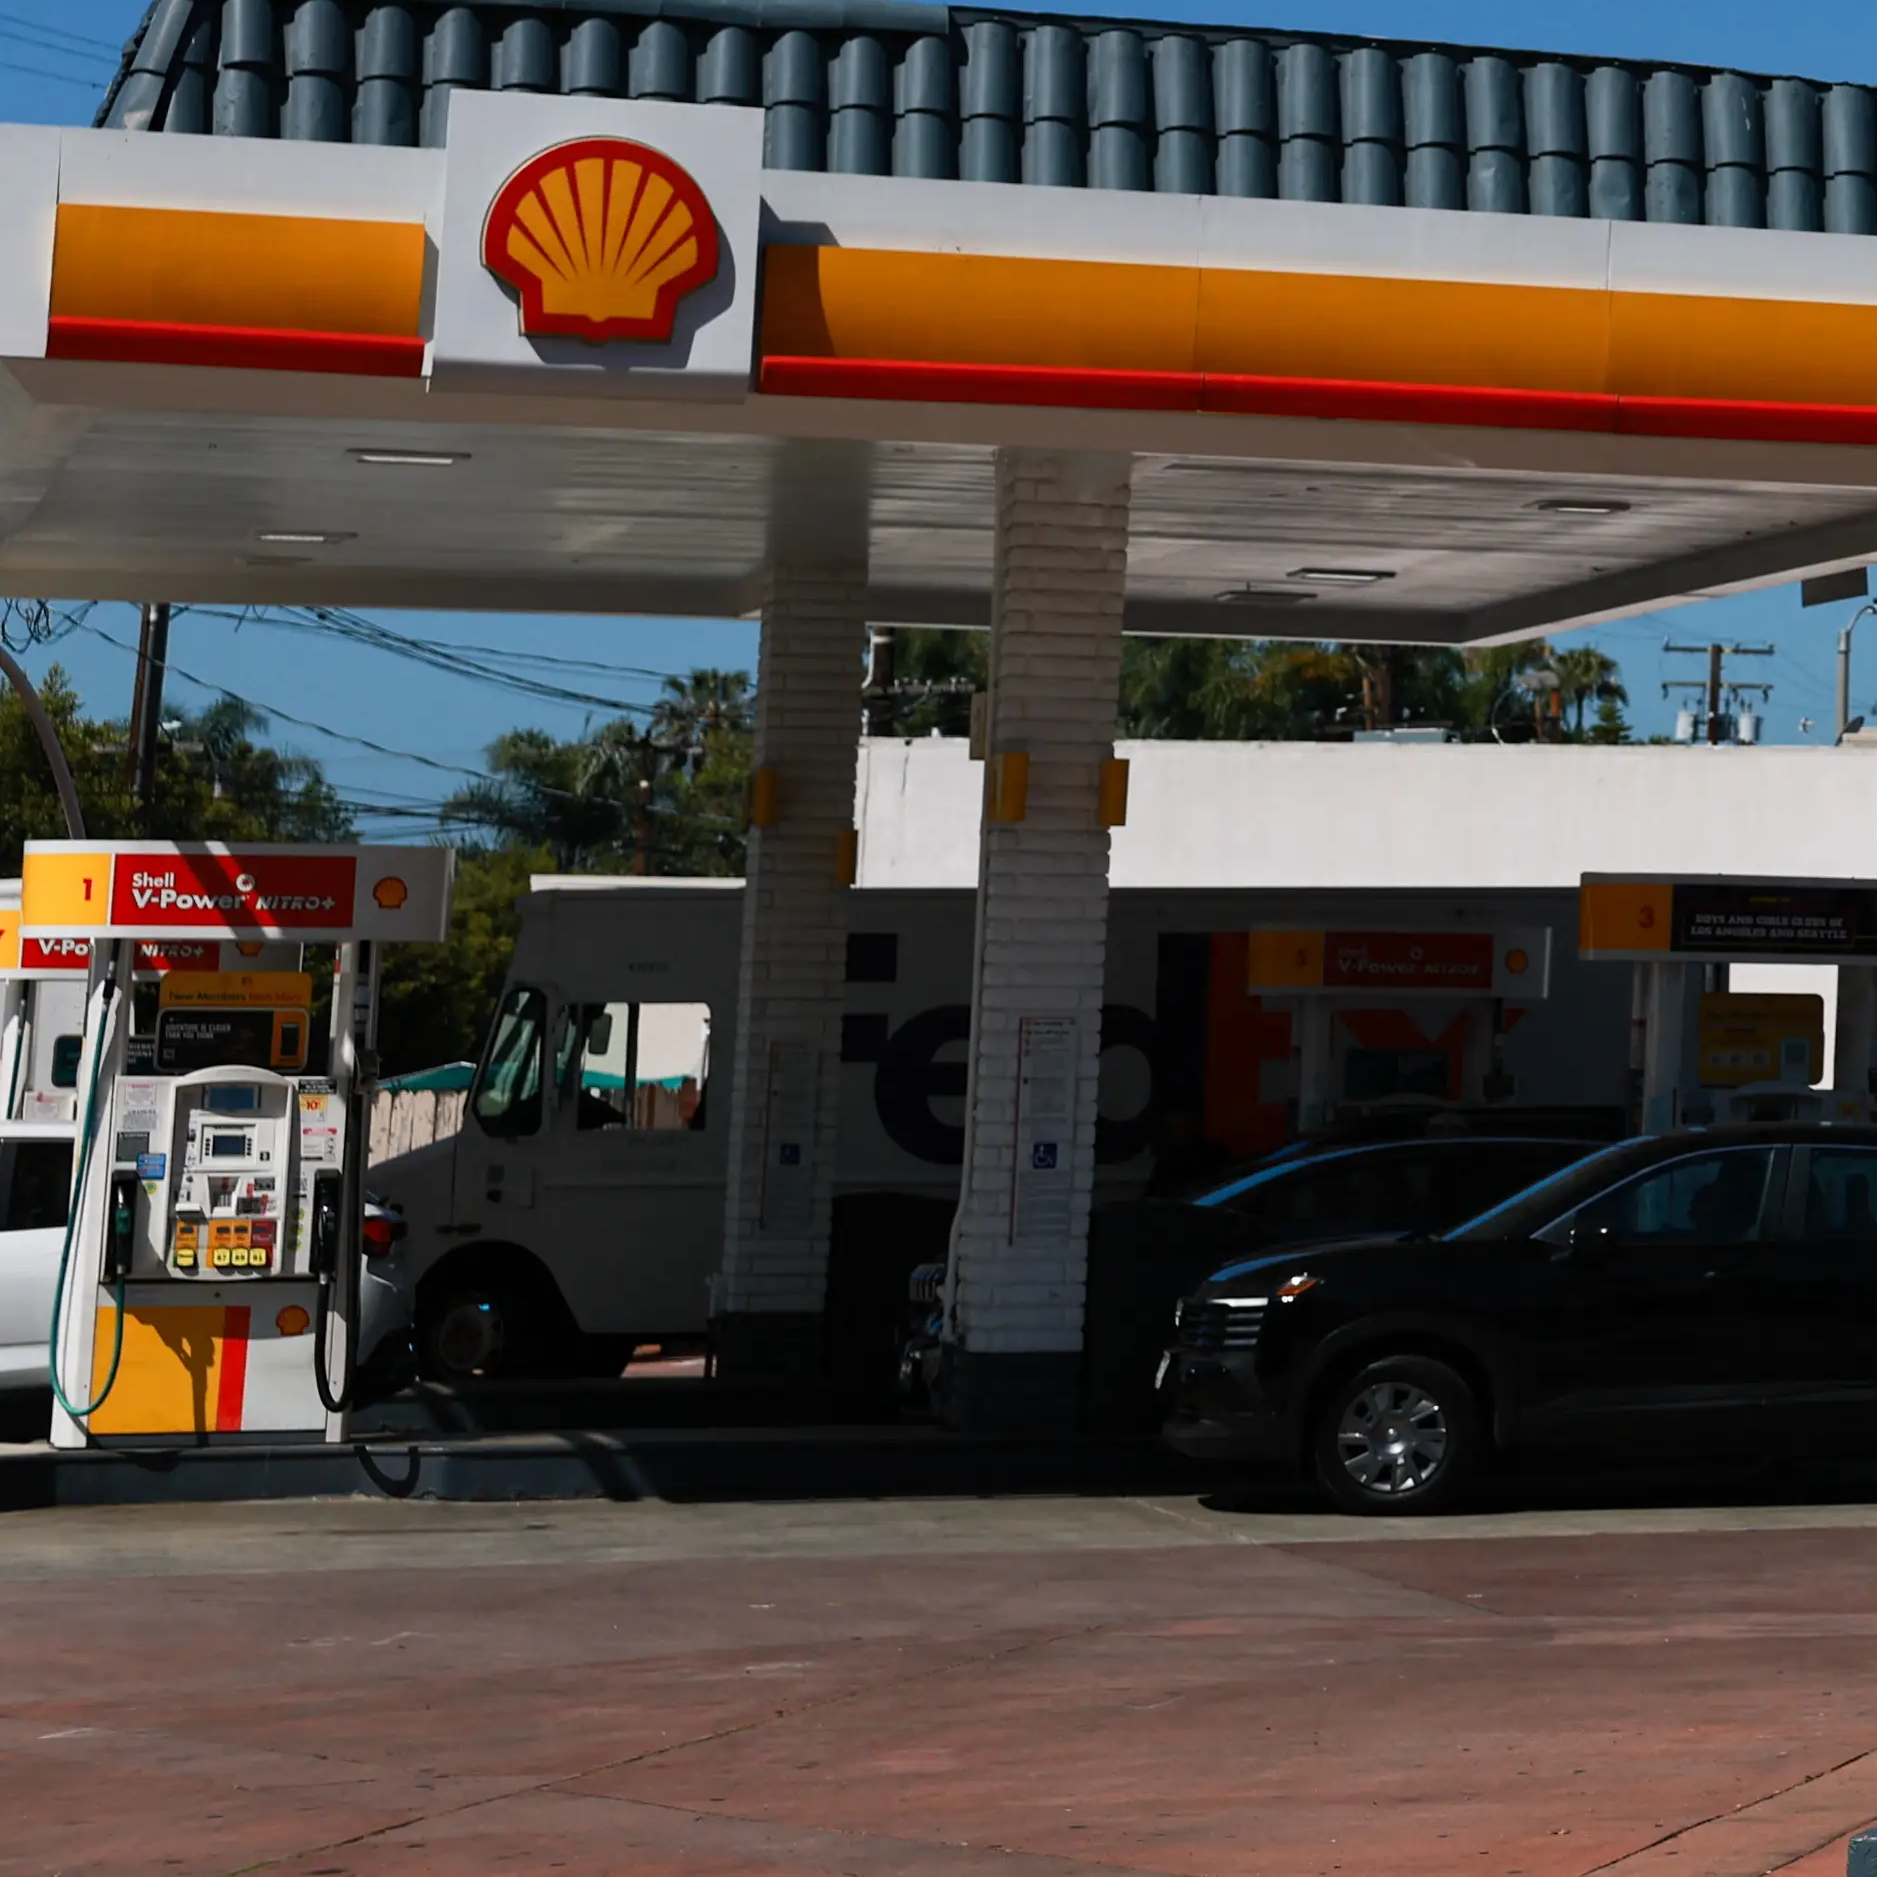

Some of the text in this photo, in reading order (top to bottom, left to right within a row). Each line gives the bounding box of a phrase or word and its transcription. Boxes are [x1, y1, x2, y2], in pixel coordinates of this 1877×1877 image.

[82, 877, 92, 901] 1
[132, 872, 175, 889] Shell
[132, 888, 246, 911] V-Power
[1637, 906, 1655, 929] 3
[1769, 927, 1794, 938] AND
[1797, 928, 1848, 939] SEATTLE
[39, 938, 91, 957] V-Po
